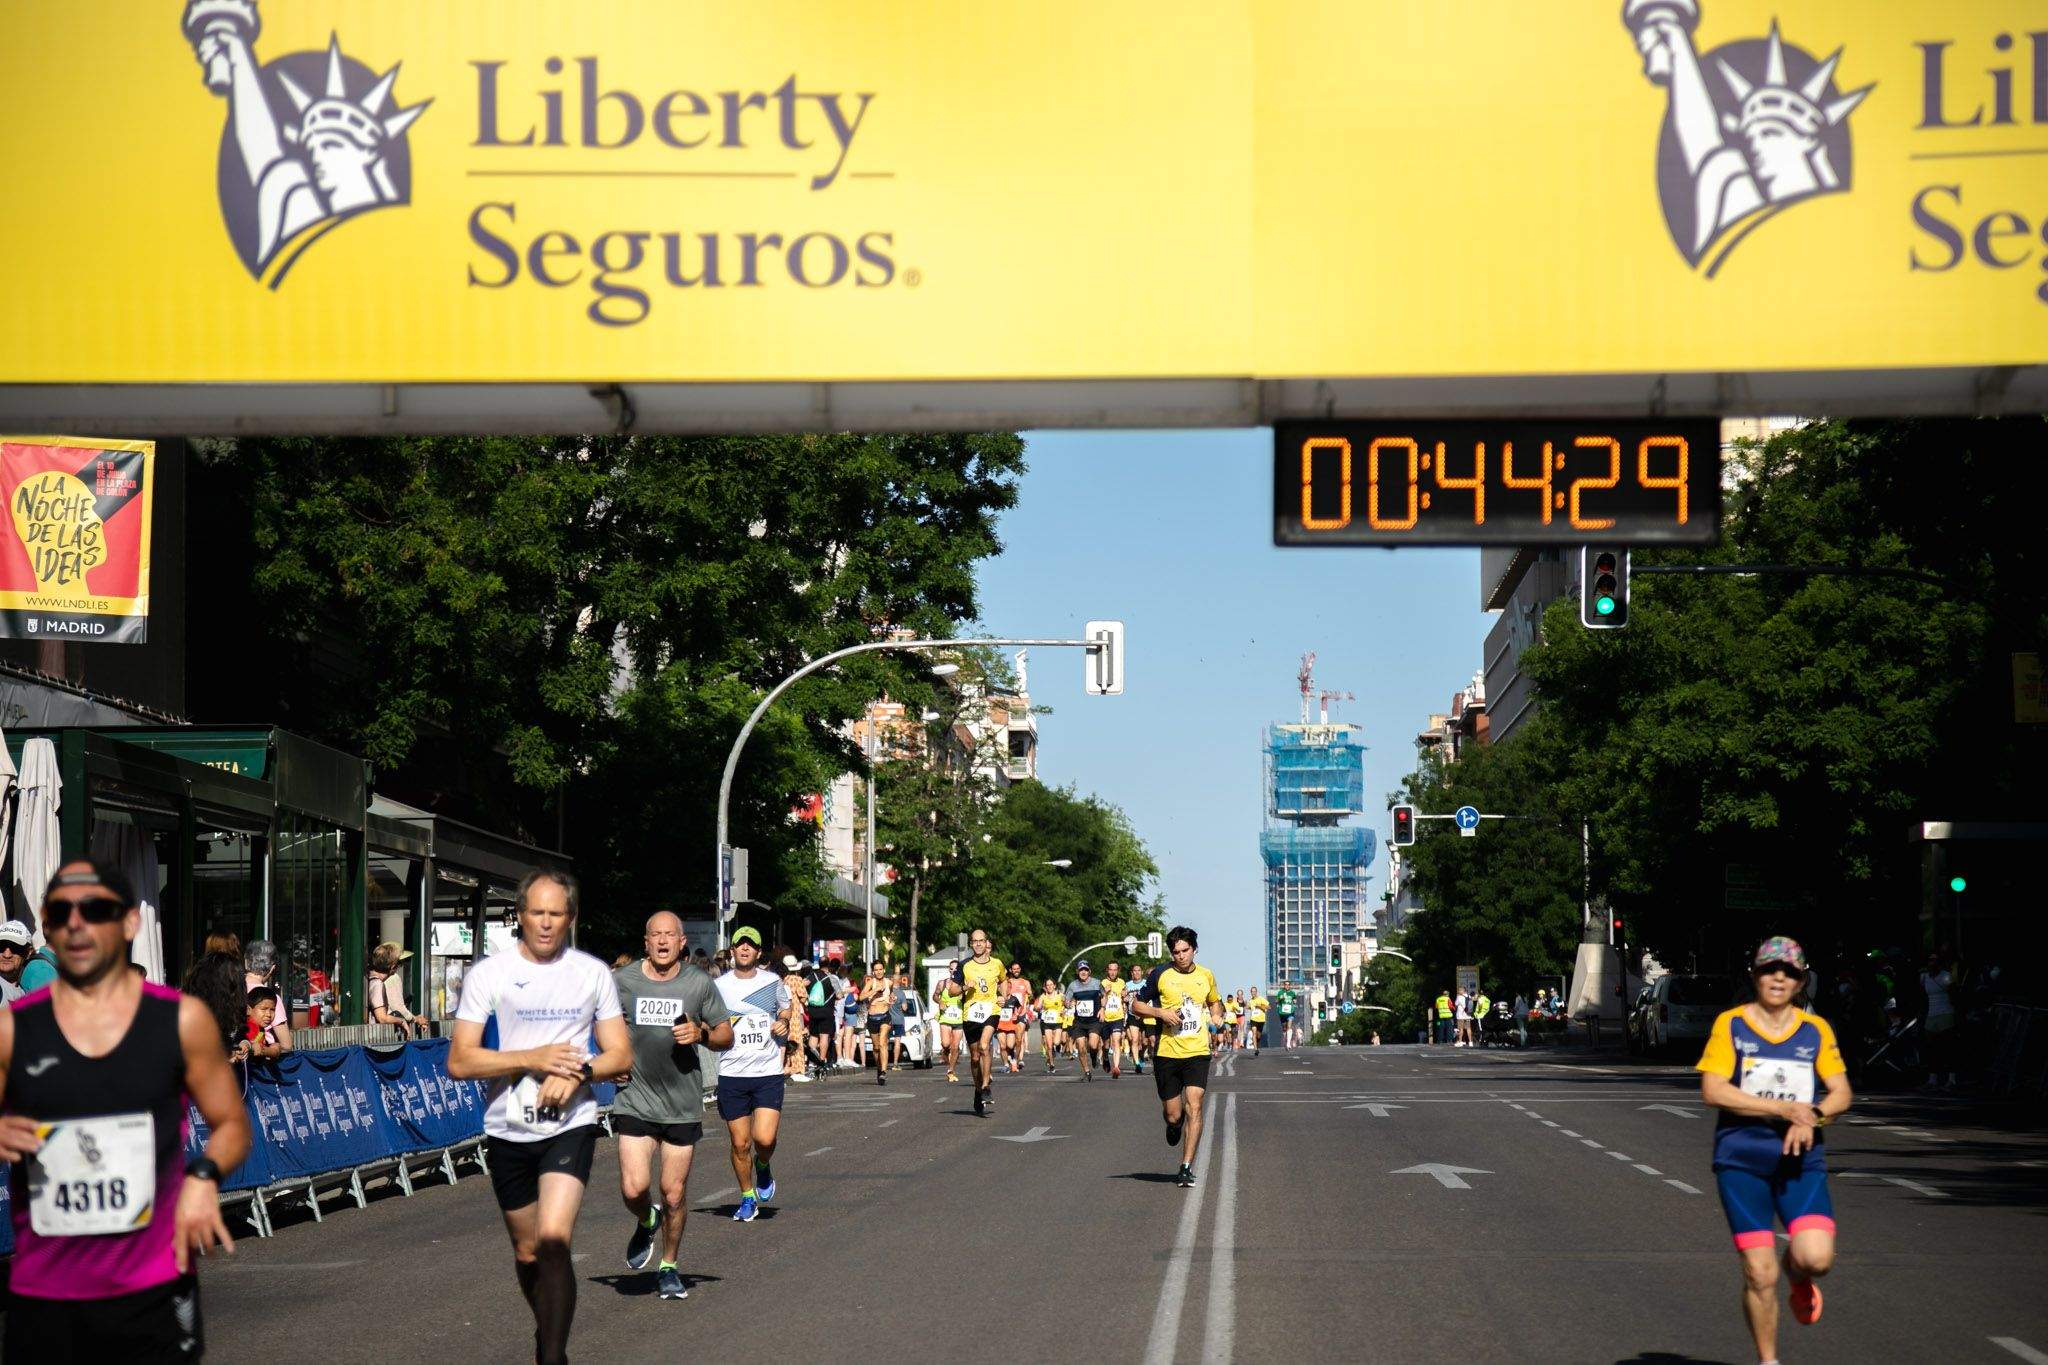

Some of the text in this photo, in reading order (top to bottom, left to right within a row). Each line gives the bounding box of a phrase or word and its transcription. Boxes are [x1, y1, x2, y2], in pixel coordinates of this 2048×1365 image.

[467, 56, 876, 191] Liberty
[1908, 183, 2048, 306] Se
[41, 475, 66, 495] LA
[1301, 435, 1689, 530] 00:44:29
[17, 484, 95, 523] NOCHE
[26, 521, 101, 550] DE LAS
[35, 546, 102, 586] IDEAS
[26, 597, 109, 611] WWW.LNDLI.ES
[46, 621, 106, 636] MADRID
[516, 1008, 547, 1016] WHITE
[557, 1008, 582, 1016] CASE
[640, 1000, 671, 1015] 2020
[640, 1017, 674, 1025] VOLVEMO
[1181, 1020, 1197, 1031] 678
[740, 1033, 763, 1044] 3175
[55, 1176, 127, 1213] 4318
